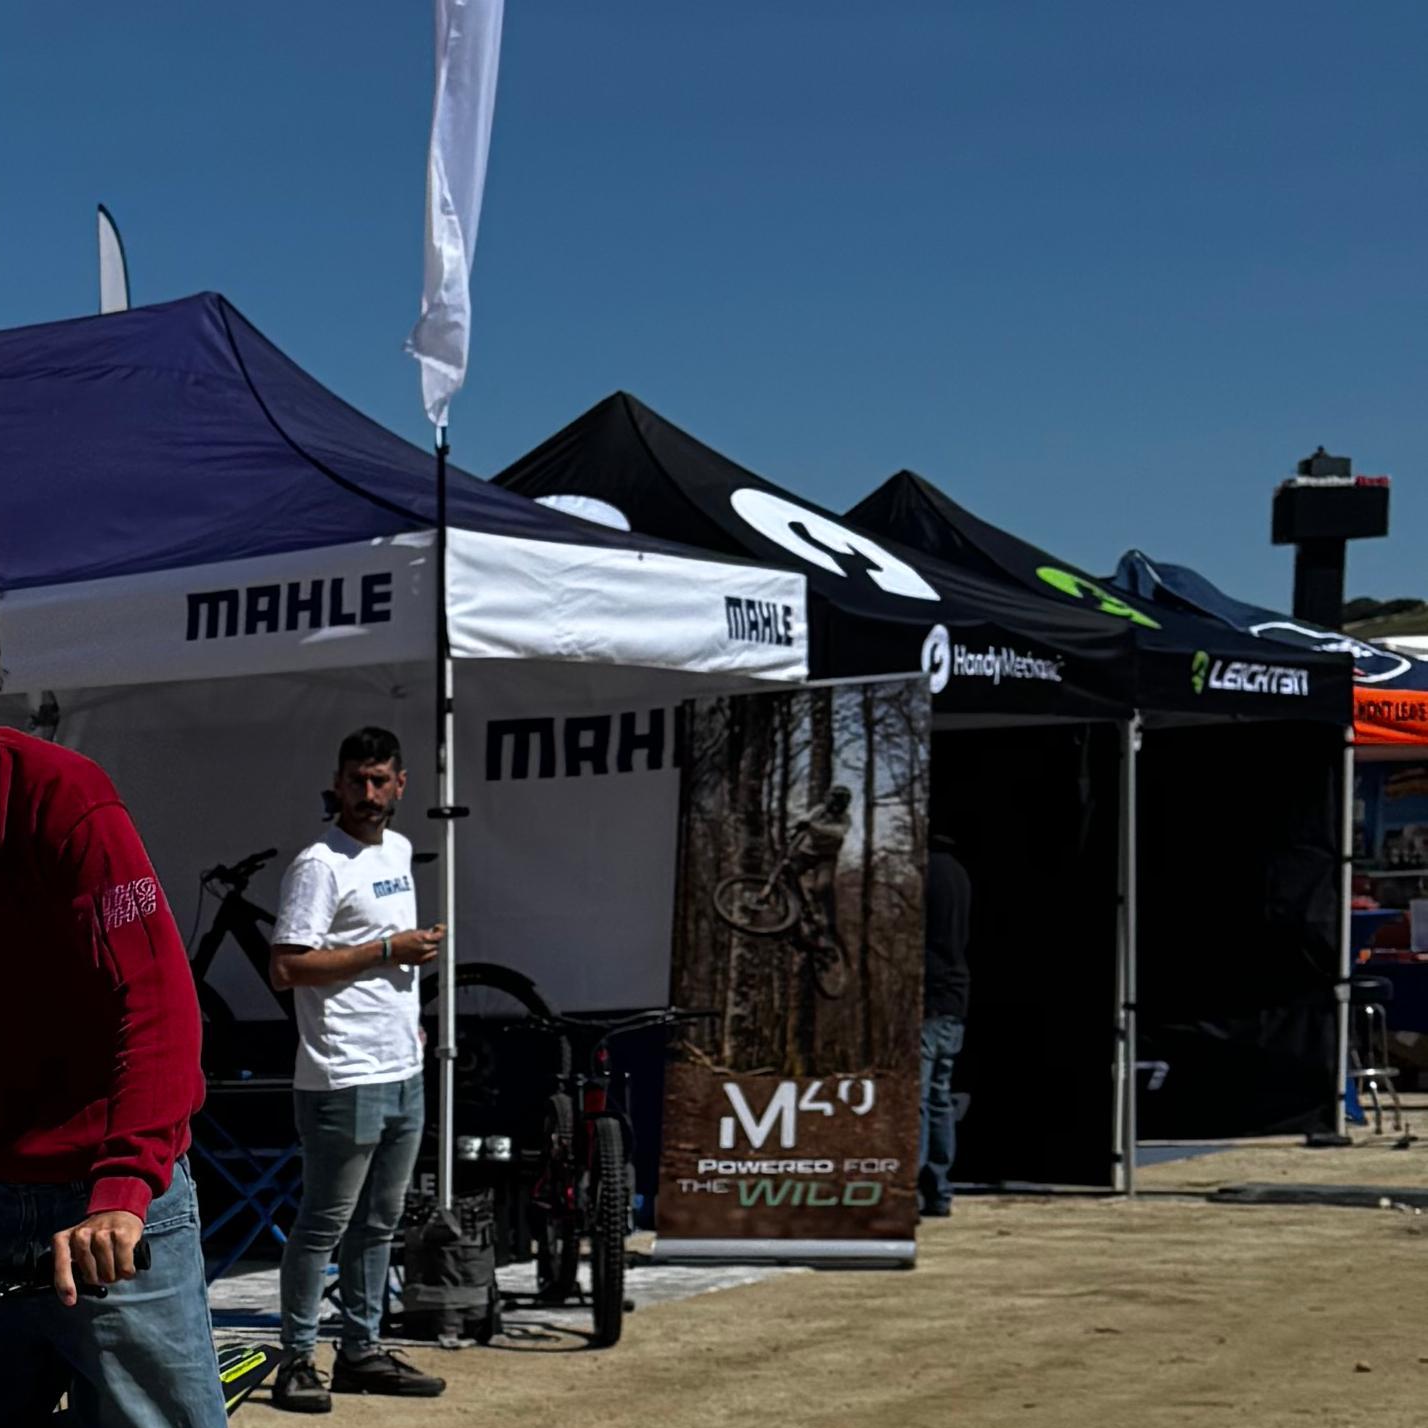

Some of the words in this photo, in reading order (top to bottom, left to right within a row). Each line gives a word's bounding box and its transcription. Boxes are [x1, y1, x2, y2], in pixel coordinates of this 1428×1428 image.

[187, 573, 392, 641] MAHLE
[724, 596, 793, 647] MAHLE
[372, 875, 411, 898] MAHLE
[697, 1158, 835, 1175] POWERED
[843, 1157, 901, 1174] FOR
[675, 1178, 731, 1194] THE
[737, 1179, 883, 1207] WILD
